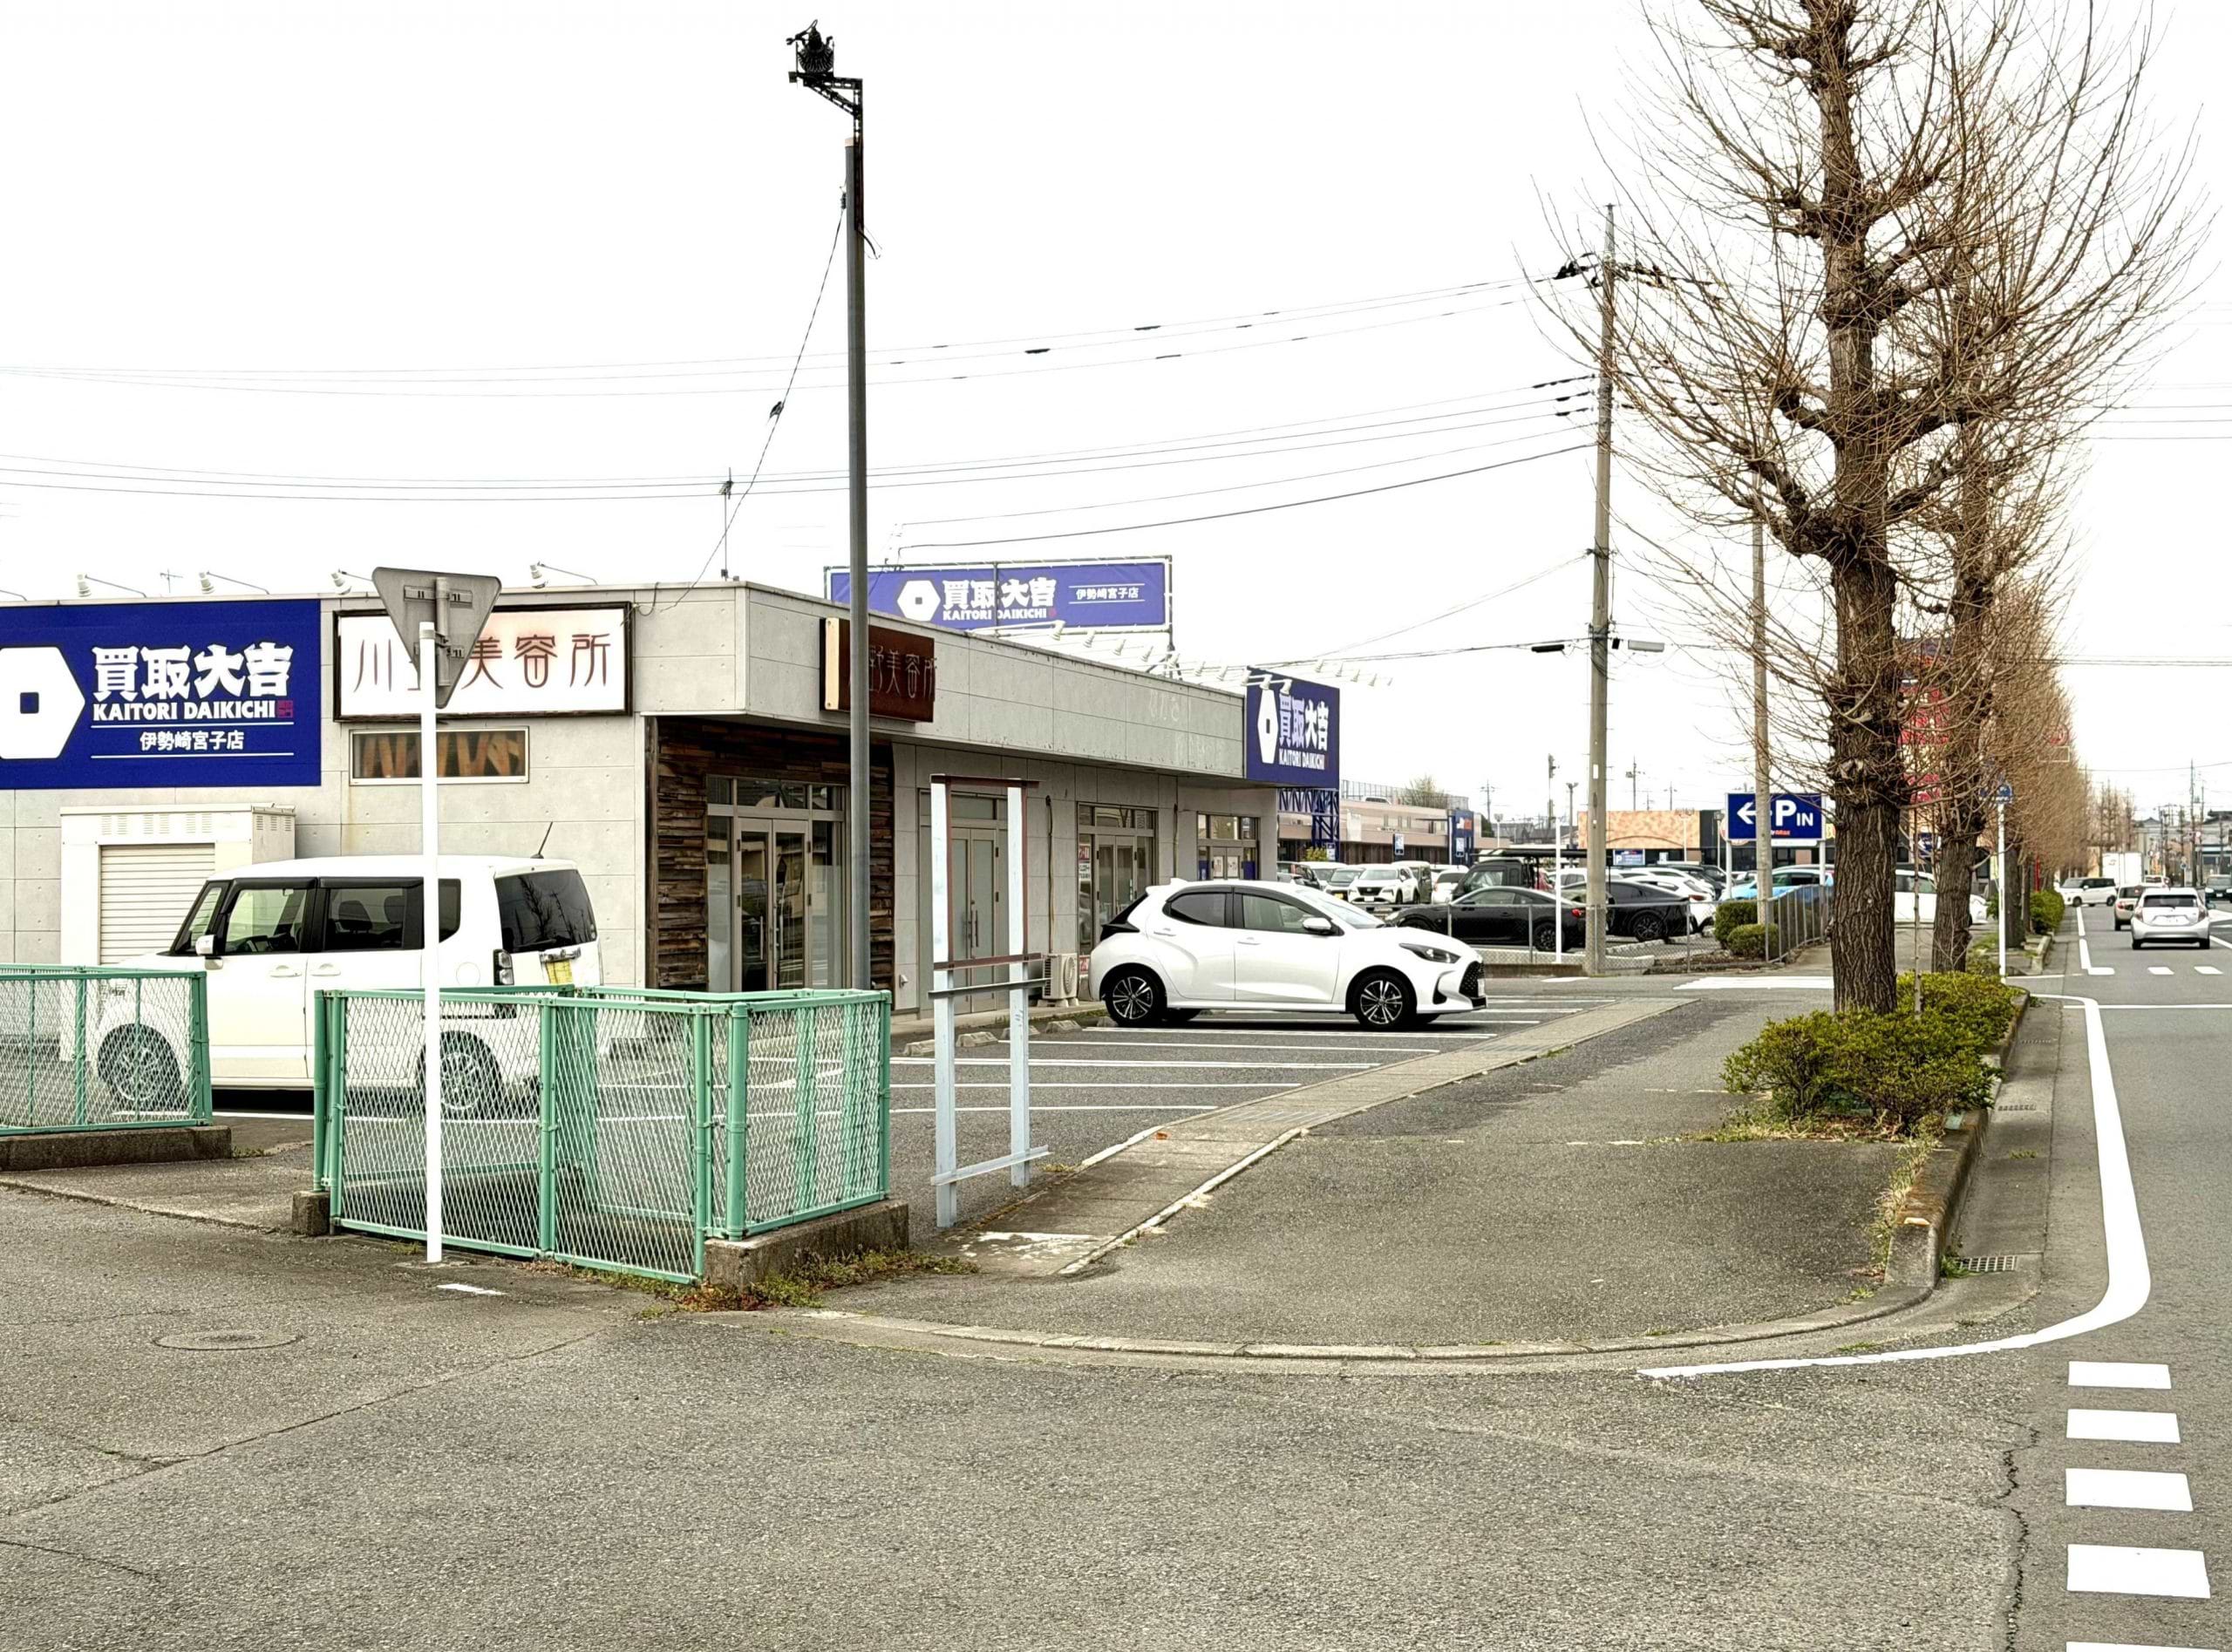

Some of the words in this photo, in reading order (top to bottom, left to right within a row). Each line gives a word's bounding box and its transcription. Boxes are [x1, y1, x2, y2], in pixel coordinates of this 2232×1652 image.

[942, 577, 1057, 609] 買取大吉
[1076, 587, 1140, 600] 伊勢崎宮子店
[943, 610, 992, 621] KAITORI
[997, 608, 1046, 620] DAIKICHI
[92, 642, 294, 702] 買取大吉
[353, 633, 611, 693] 川美容所
[93, 702, 178, 721] KAITORI
[184, 700, 276, 719] DAIKICHI
[1279, 693, 1329, 751] 買取大吉
[140, 731, 244, 751] 伊勢崎宮子店
